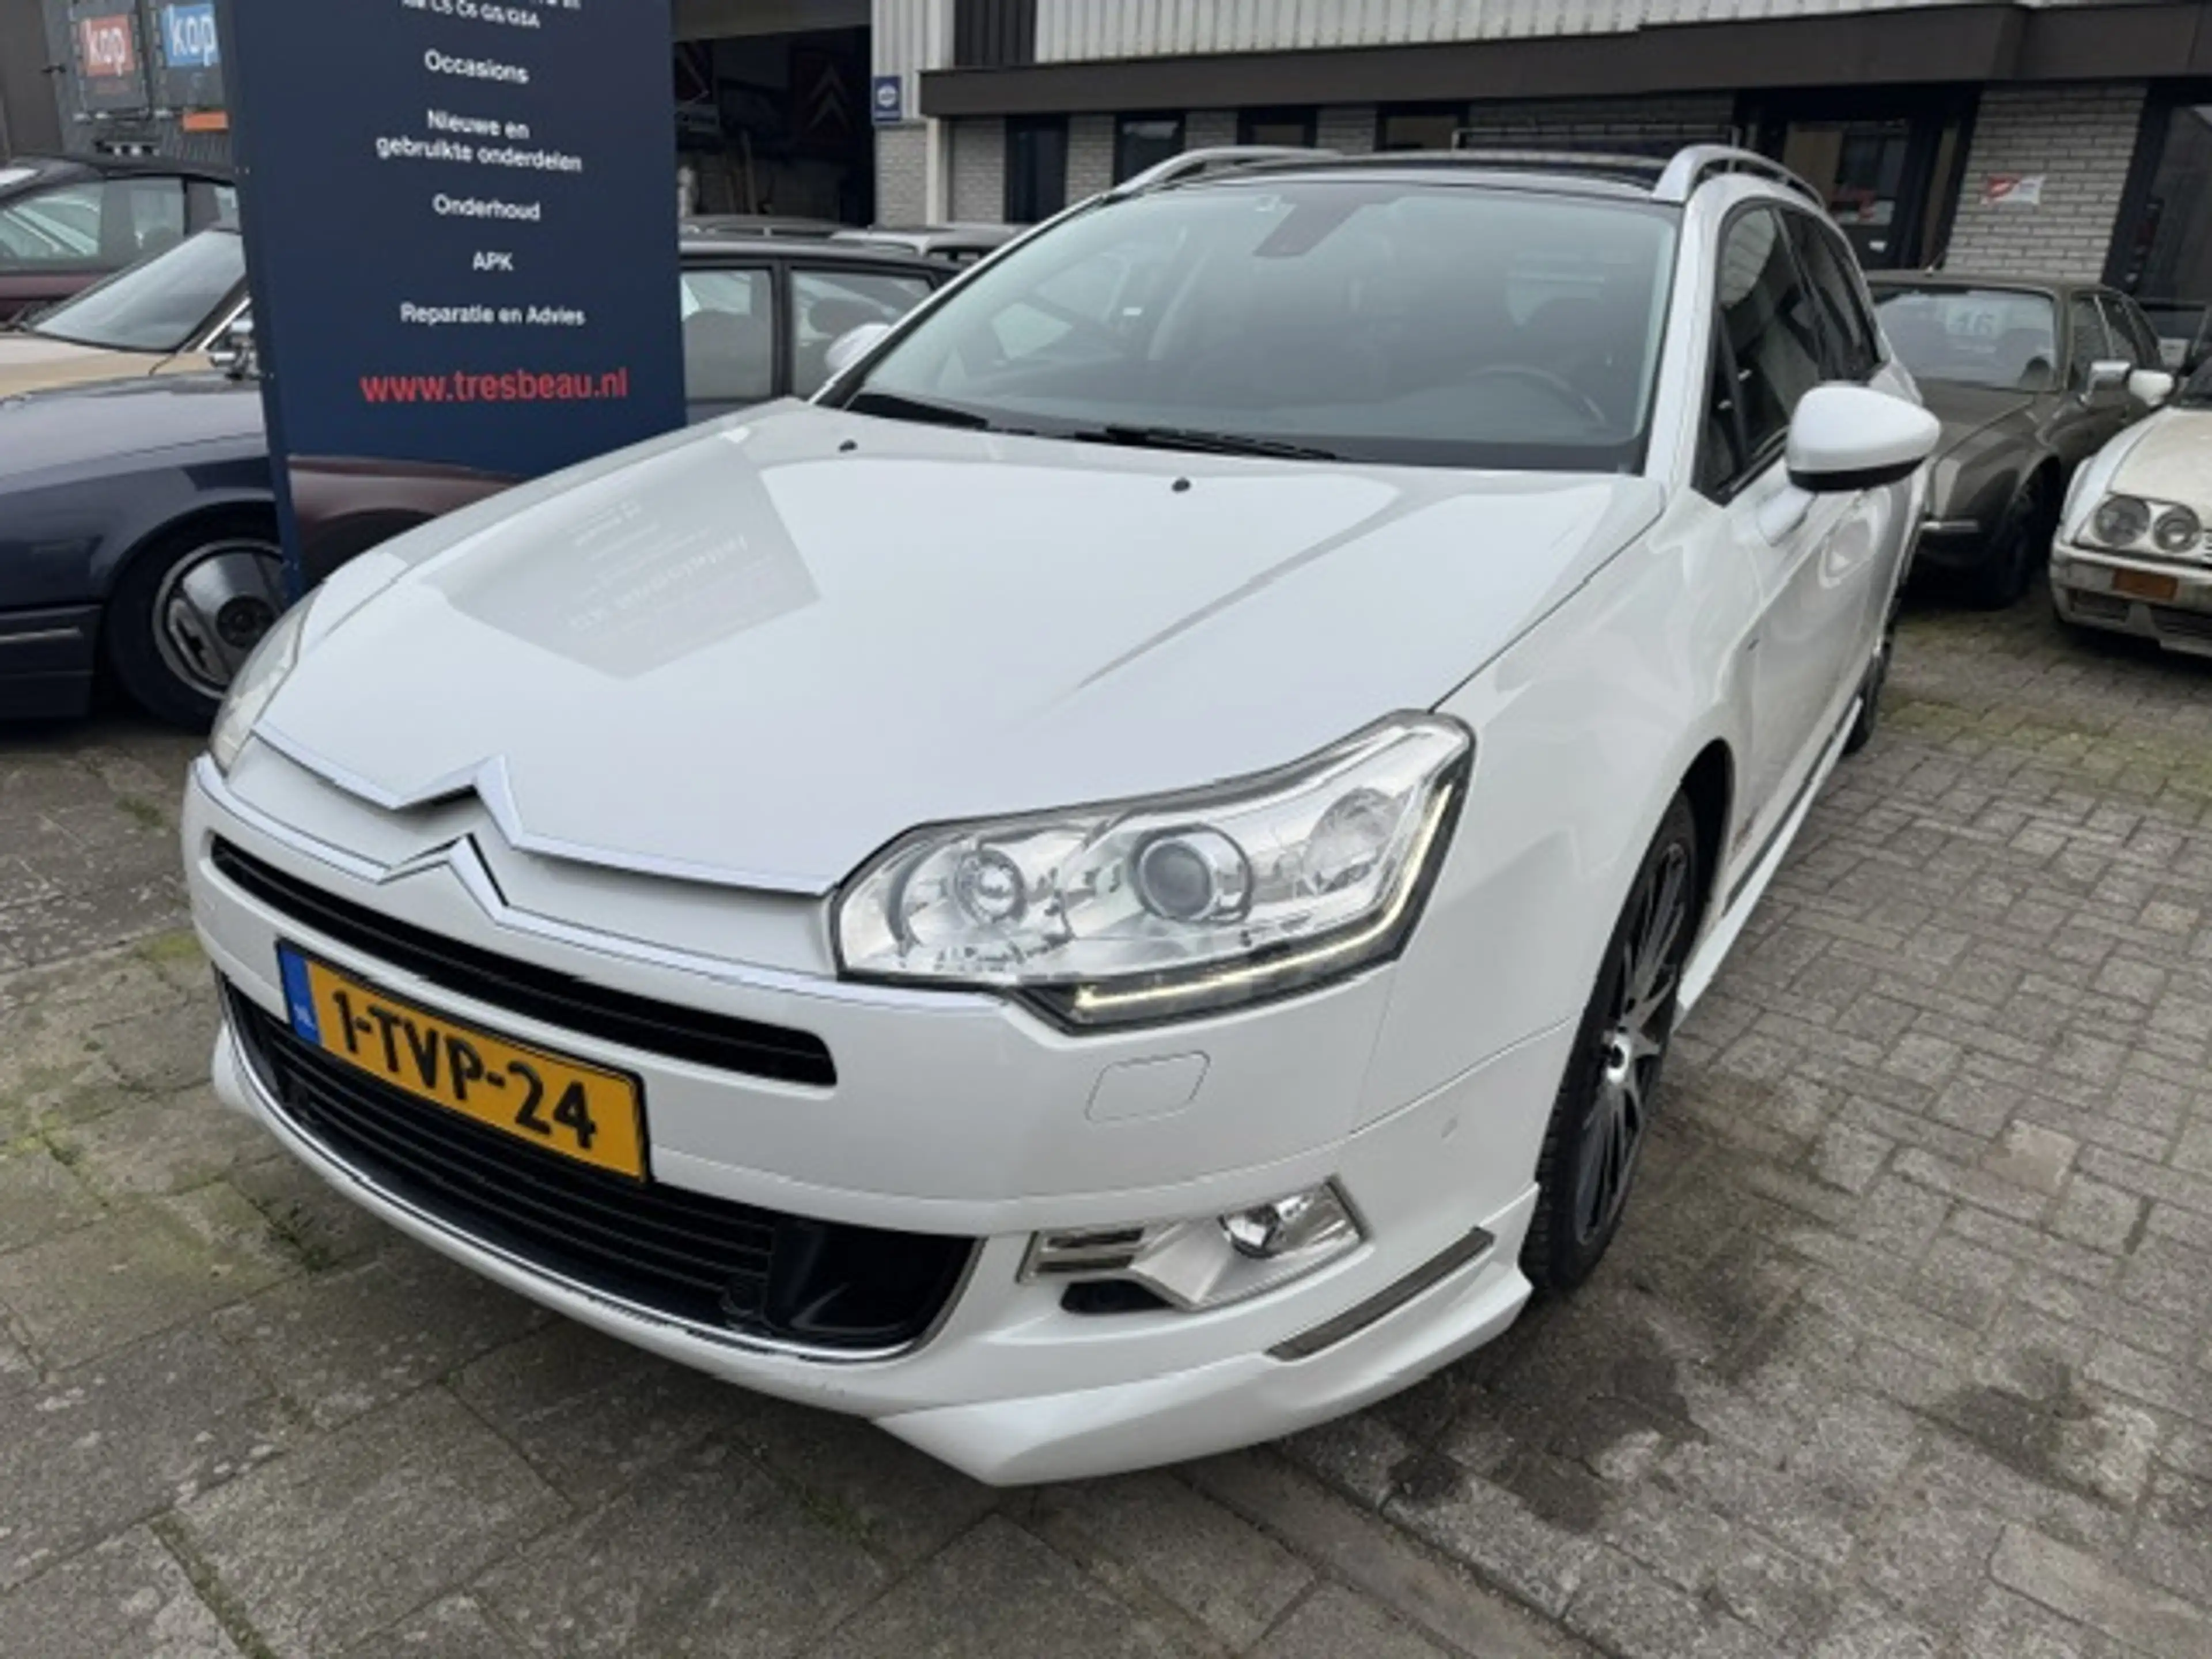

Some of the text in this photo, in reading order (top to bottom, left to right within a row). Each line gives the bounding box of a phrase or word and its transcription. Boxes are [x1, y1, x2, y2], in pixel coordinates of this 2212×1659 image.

[82, 18, 126, 77] kop
[169, 3, 215, 68] kop
[424, 48, 529, 84] Occasions
[427, 109, 531, 139] Nieuwe en
[376, 136, 582, 172] gebruikte onderdelen
[433, 193, 541, 221] Onderhoud
[472, 251, 513, 271] APK
[400, 302, 586, 326] Reparatie en Advies
[359, 366, 628, 403] www.tresbeau.nl
[332, 988, 597, 1149] 1-TVP-24
